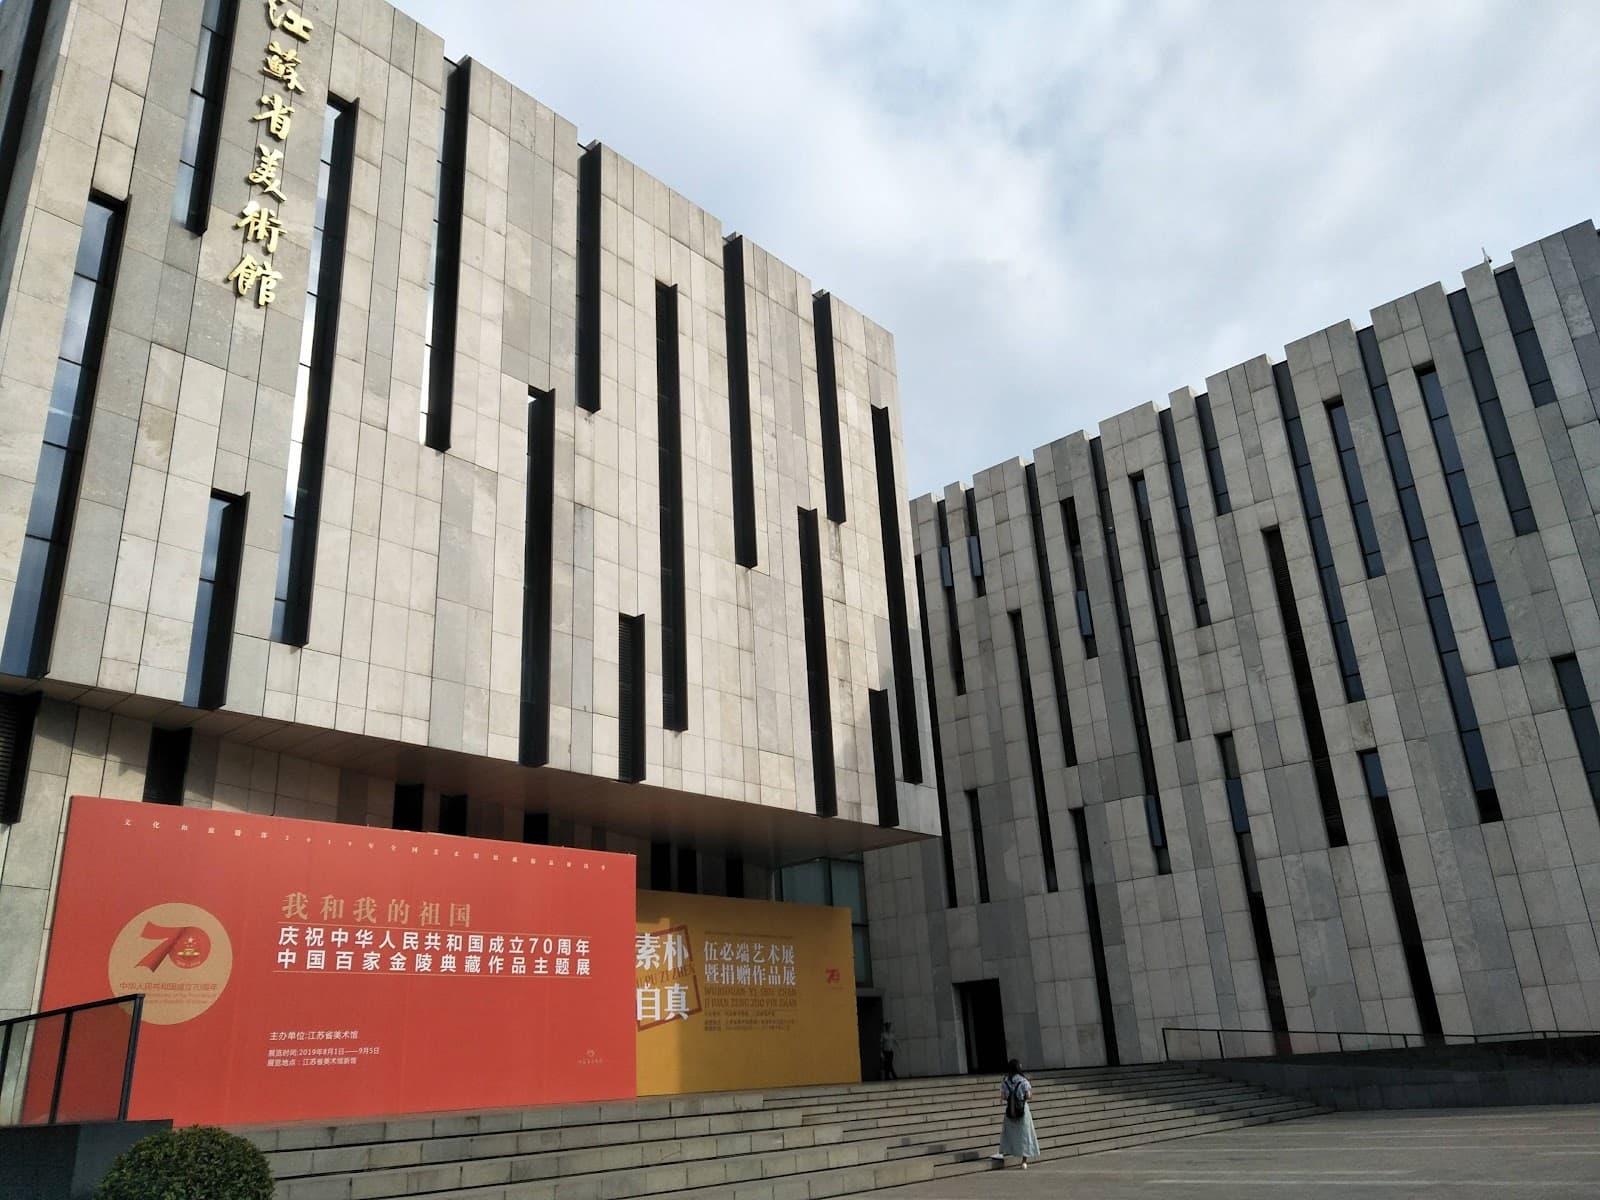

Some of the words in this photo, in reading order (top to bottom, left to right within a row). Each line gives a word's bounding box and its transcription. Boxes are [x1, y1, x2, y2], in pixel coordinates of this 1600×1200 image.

[281, 891, 472, 928] 我和我的祖国
[278, 926, 591, 956] 庆祝中华人民共和国成立70周年
[703, 940, 795, 965] 伍必端艺术展
[276, 948, 591, 976] 中国百家金陵典藏作品主题展
[704, 963, 797, 986] 暨捐赠作品展
